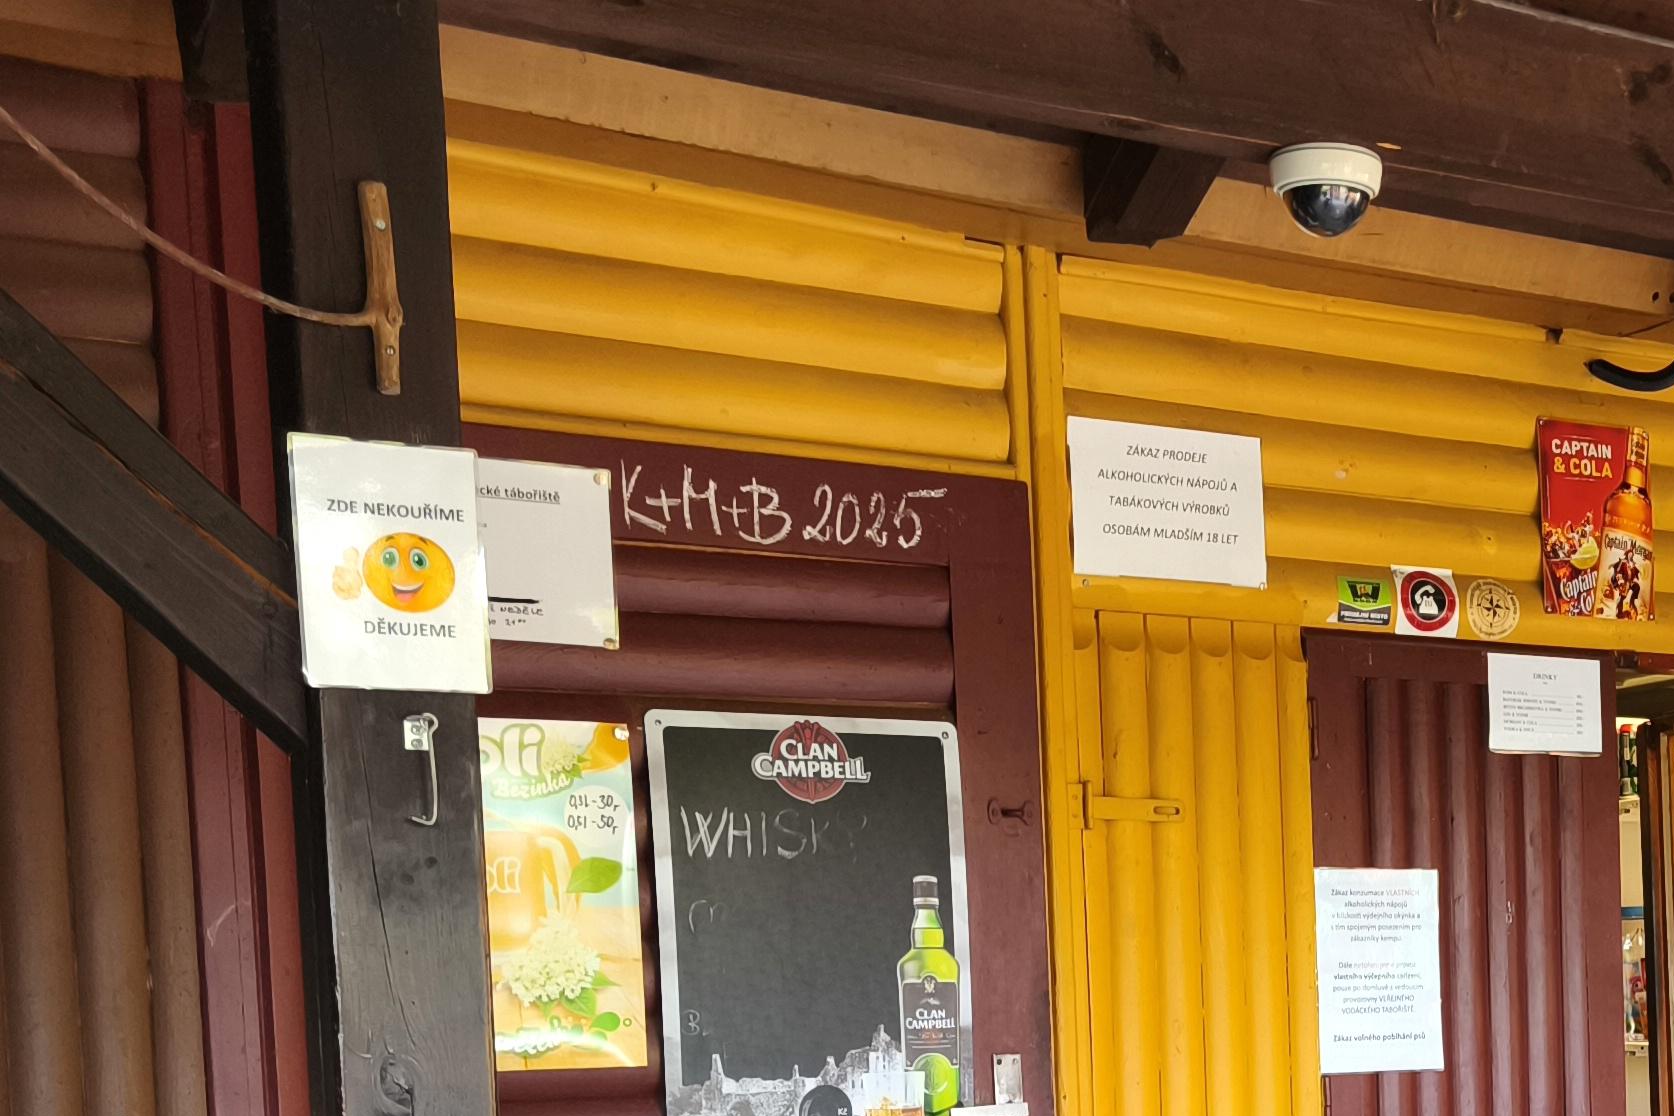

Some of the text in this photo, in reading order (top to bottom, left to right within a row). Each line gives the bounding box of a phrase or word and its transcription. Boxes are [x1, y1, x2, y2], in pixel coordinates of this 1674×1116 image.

[1126, 444, 1208, 464] ZÁKAZ PRODEJE
[1551, 438, 1612, 460] CAPTAIN
[1553, 456, 1613, 479] & COLA
[1097, 467, 1238, 492] ALKOHOLICKÝCH NÁPOJŮ A
[504, 485, 561, 504] tábořiště
[327, 498, 465, 523] ZDE NEKOUŘÍME
[802, 482, 948, 549] 2025
[1108, 495, 1230, 517] TABÁKOVÝCH VÝROBKŮ
[1102, 522, 1239, 545] OSOBÁM MLADŠÍM 18 LET
[364, 617, 457, 639] DĚKUJEME
[779, 738, 838, 761] CLAN
[753, 754, 869, 780] CAMPBELL
[905, 1017, 956, 1030] CAMPBELL
[915, 1008, 946, 1020] CLAN
